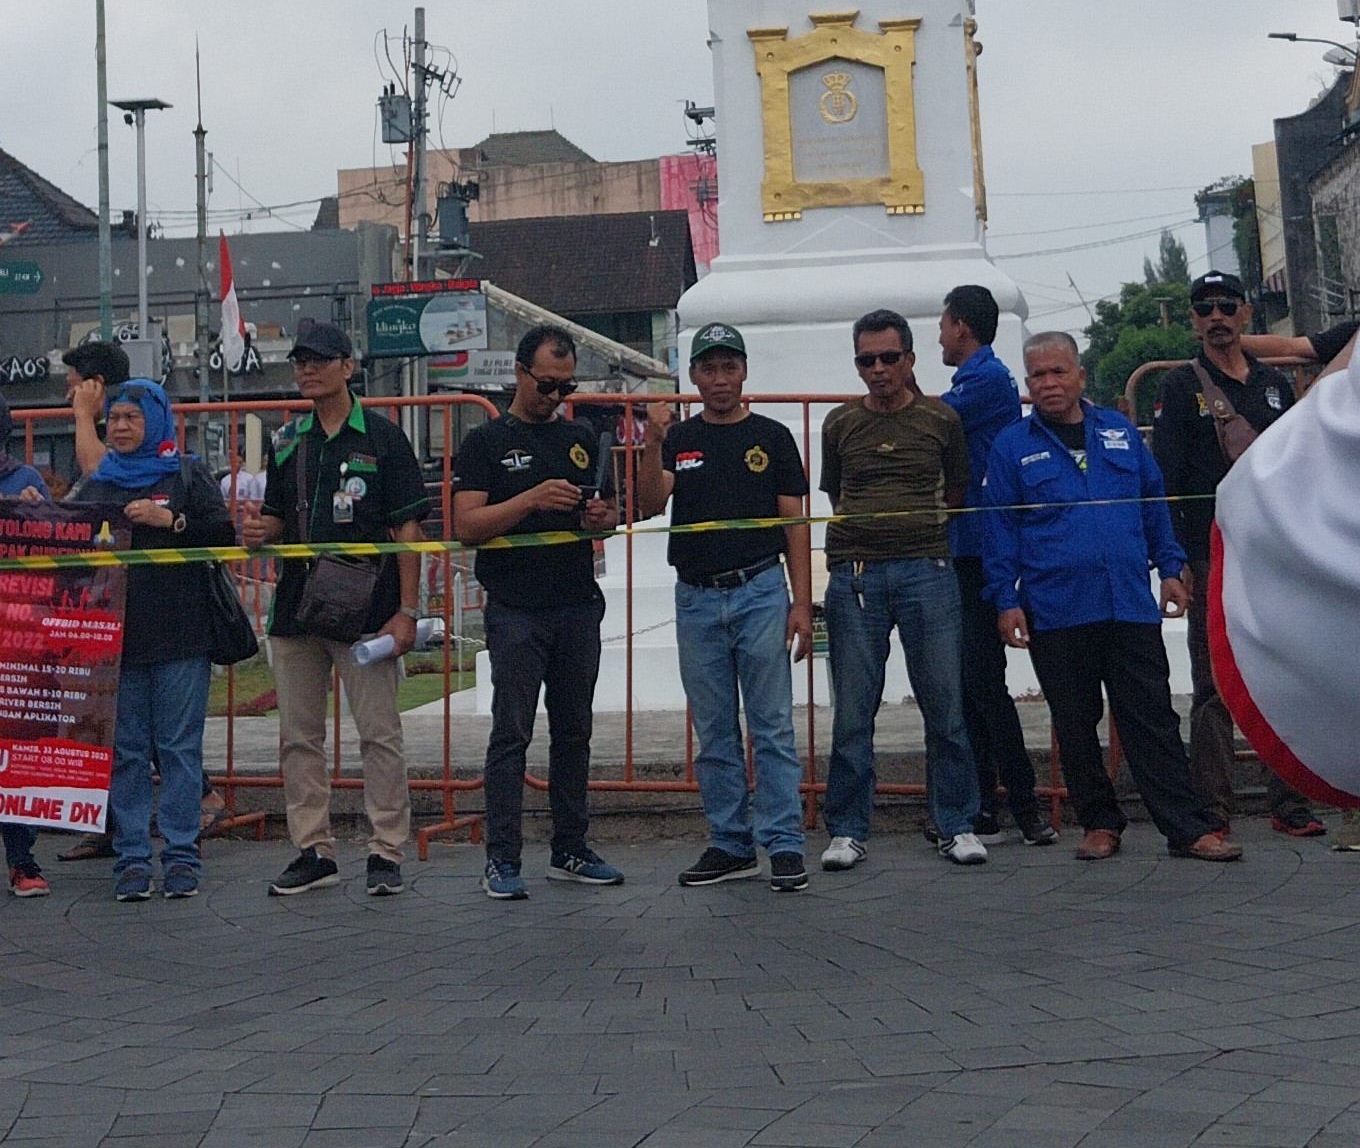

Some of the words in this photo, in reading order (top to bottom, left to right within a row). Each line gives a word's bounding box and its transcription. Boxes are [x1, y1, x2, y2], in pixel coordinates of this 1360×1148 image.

[55, 522, 92, 541] KAMI
[6, 602, 35, 621] NO.
[48, 629, 66, 639] JAM
[0, 661, 40, 673] MINIMAL
[41, 664, 66, 674] 15-20
[68, 667, 91, 677] RIBU
[6, 686, 41, 697] BAWAH
[42, 688, 62, 699] 5-10
[63, 691, 87, 701] RIBU
[27, 700, 62, 711] BERSIH
[23, 711, 76, 724] APLIKATOR
[11, 753, 39, 763] START
[67, 758, 84, 768] WIB
[53, 746, 90, 759] AGUSTUS
[91, 750, 109, 761] 2023
[69, 801, 103, 827] DIY
